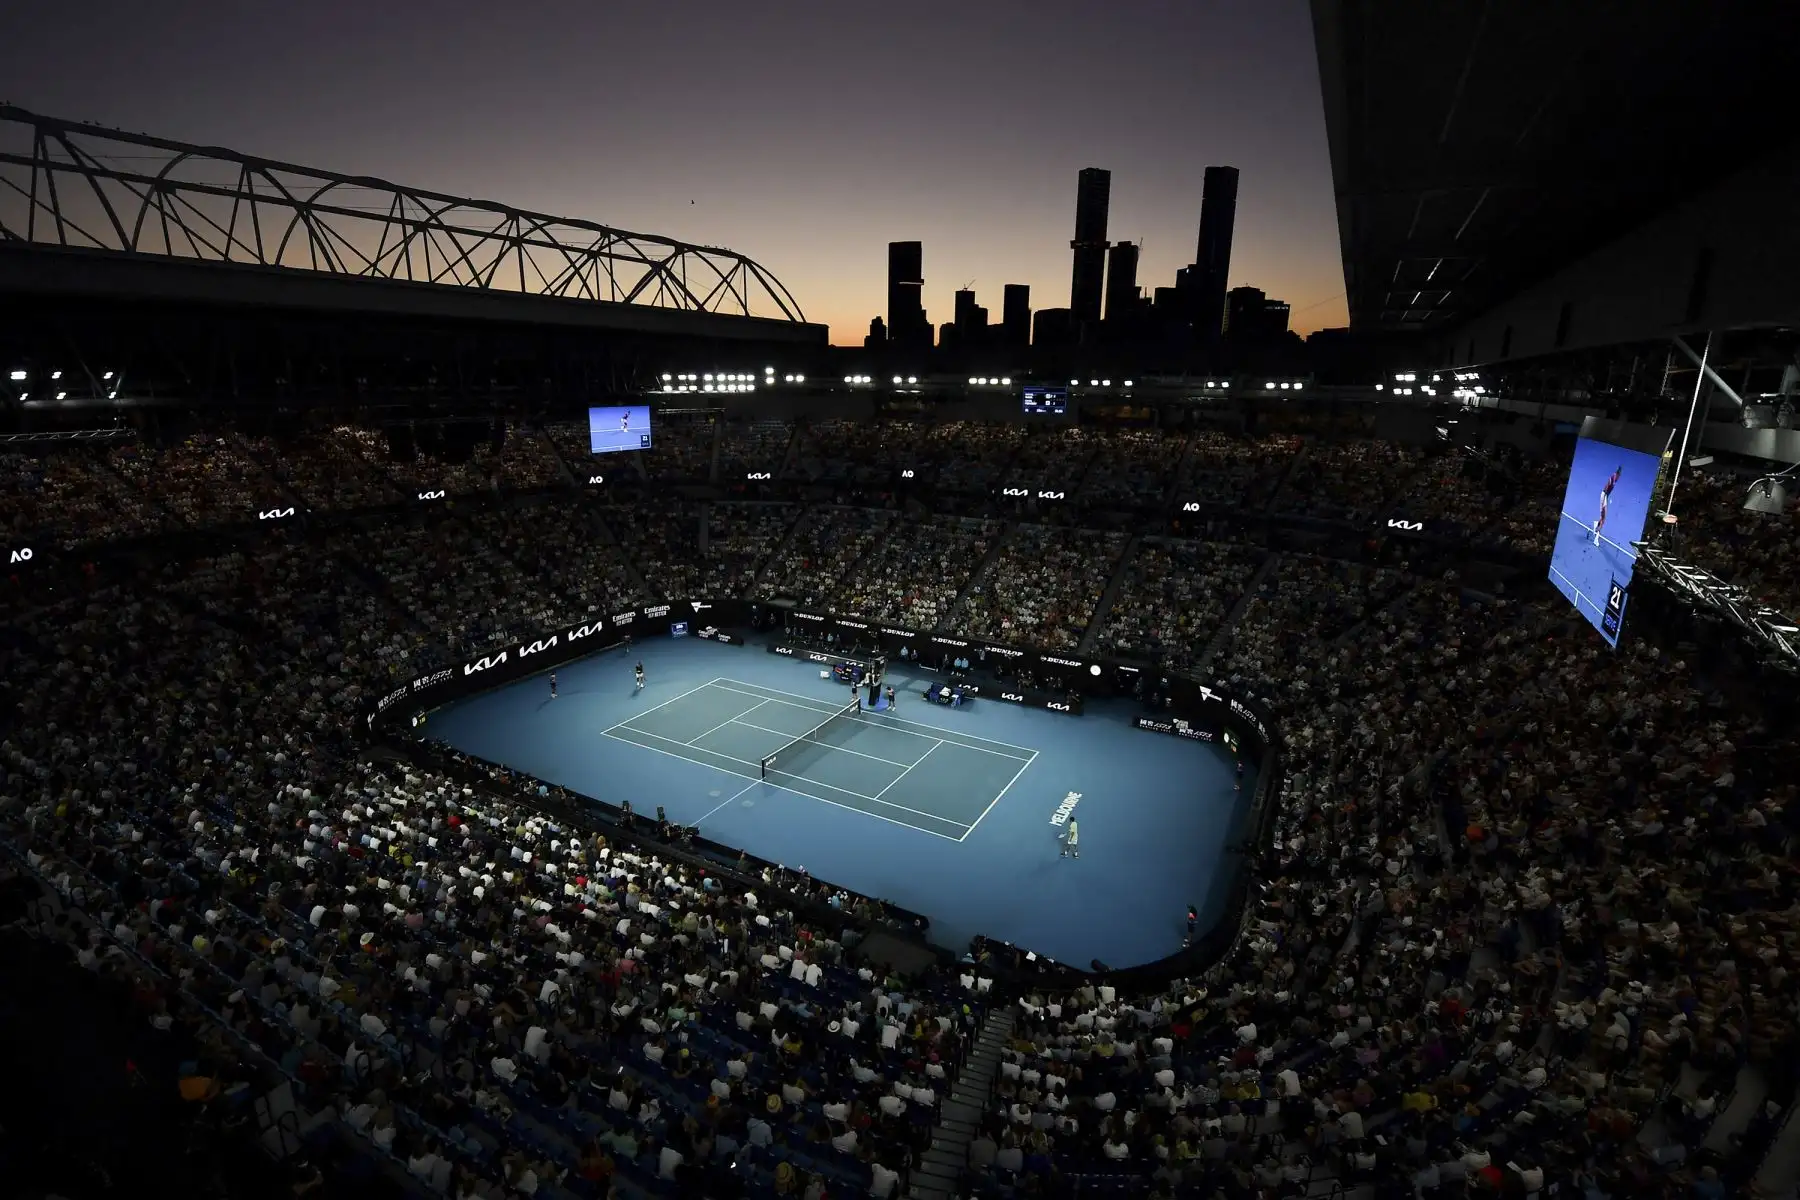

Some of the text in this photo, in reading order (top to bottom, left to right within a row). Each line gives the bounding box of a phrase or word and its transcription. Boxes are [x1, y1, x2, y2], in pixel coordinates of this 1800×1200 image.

[902, 470, 914, 478] AO
[589, 475, 603, 484] AO
[1183, 502, 1200, 512] AO
[10, 548, 33, 563] AO
[1610, 586, 1621, 610] 21
[644, 605, 671, 614] Emirates
[612, 611, 636, 623] Emirates
[799, 613, 825, 621] DUNLOP
[841, 621, 868, 629] DUNLOP
[567, 620, 603, 642] KIA
[887, 628, 916, 637] DUNLOP
[937, 637, 968, 646] DUNLOP
[519, 636, 558, 658] KIA
[991, 647, 1024, 656] DUNLOP
[463, 651, 508, 676] KIA
[1047, 657, 1082, 667] DUNLOP
